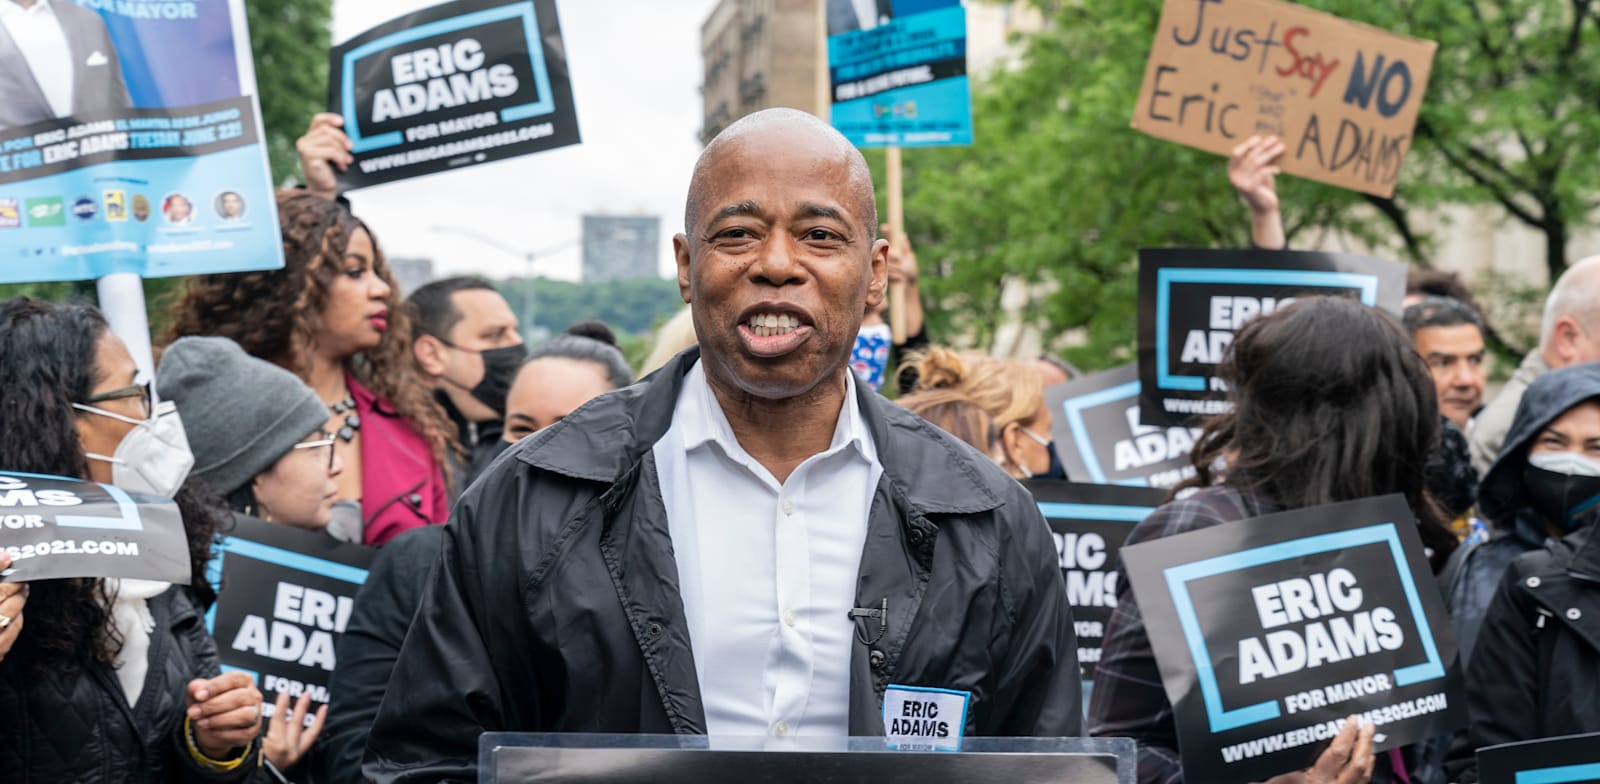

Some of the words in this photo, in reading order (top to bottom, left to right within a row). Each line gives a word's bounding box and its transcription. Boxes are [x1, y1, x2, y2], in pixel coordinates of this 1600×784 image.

[118, 1, 198, 20] MAYOR
[391, 38, 486, 86] ERIC
[1172, 0, 1283, 74] Just
[1276, 27, 1340, 97] Say
[1343, 48, 1412, 118] NO
[371, 63, 520, 123] ADAMS
[34, 128, 66, 147] ERIC
[67, 119, 115, 140] ADAMS
[405, 123, 439, 143] FOR
[439, 111, 498, 136] MAYOR
[1148, 65, 1240, 139] Eric
[1296, 113, 1407, 185] ADAMS
[12, 148, 42, 171] FOR
[42, 140, 79, 165] ERIC
[80, 131, 128, 156] ADAMS
[182, 125, 216, 147] JUNE
[1209, 295, 1297, 331] ERI
[1114, 426, 1204, 471] ADA
[0, 540, 139, 562] S2021.COM
[274, 580, 354, 634] ERI
[1251, 567, 1364, 630] ERIC
[232, 614, 336, 671] ADA
[1237, 606, 1404, 685] ADAMS
[264, 674, 304, 698] FOR
[1284, 688, 1326, 715] FOR
[1323, 673, 1392, 704] MAYOR
[890, 717, 949, 738] ADAMS
[902, 700, 939, 719] ERIC
[1220, 692, 1448, 764] WWW.ERICADMS2021.COM
